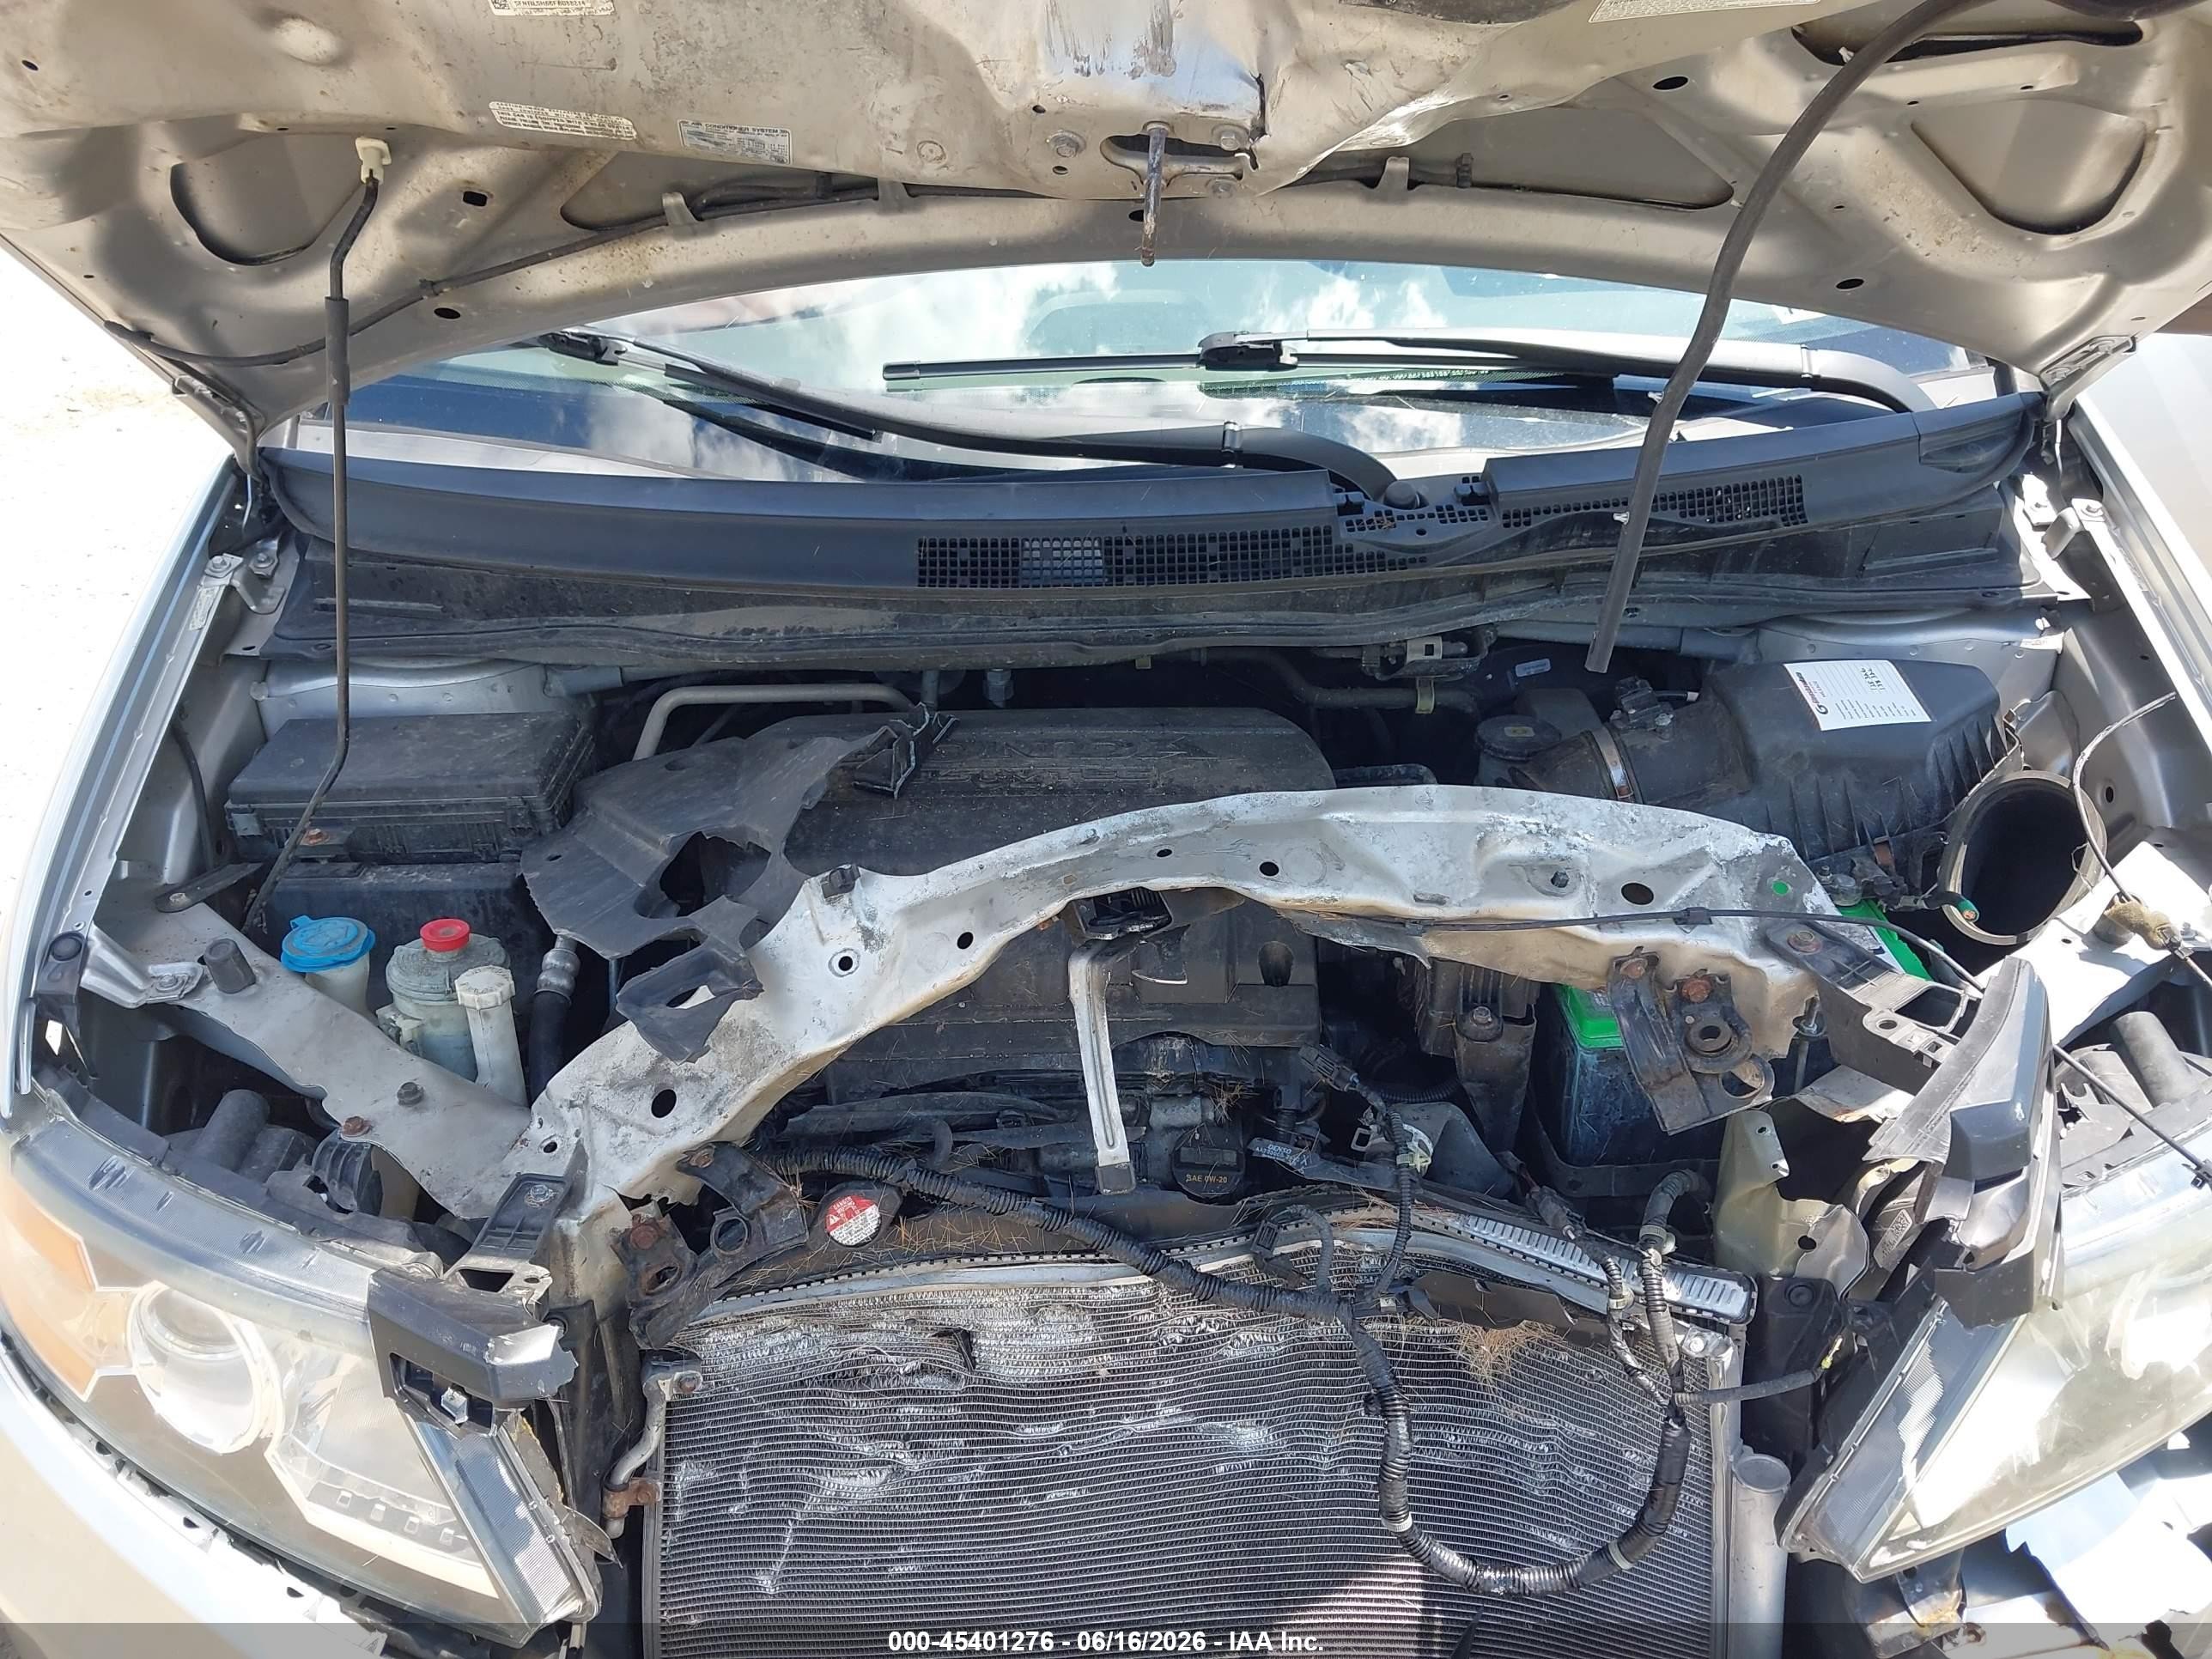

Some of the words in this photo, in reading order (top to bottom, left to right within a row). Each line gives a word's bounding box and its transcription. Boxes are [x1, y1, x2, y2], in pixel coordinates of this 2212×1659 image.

[1267, 1144, 1292, 1155] DENSO
[1186, 1174, 1202, 1183] SAE
[1204, 1175, 1228, 1184] 0W-20
